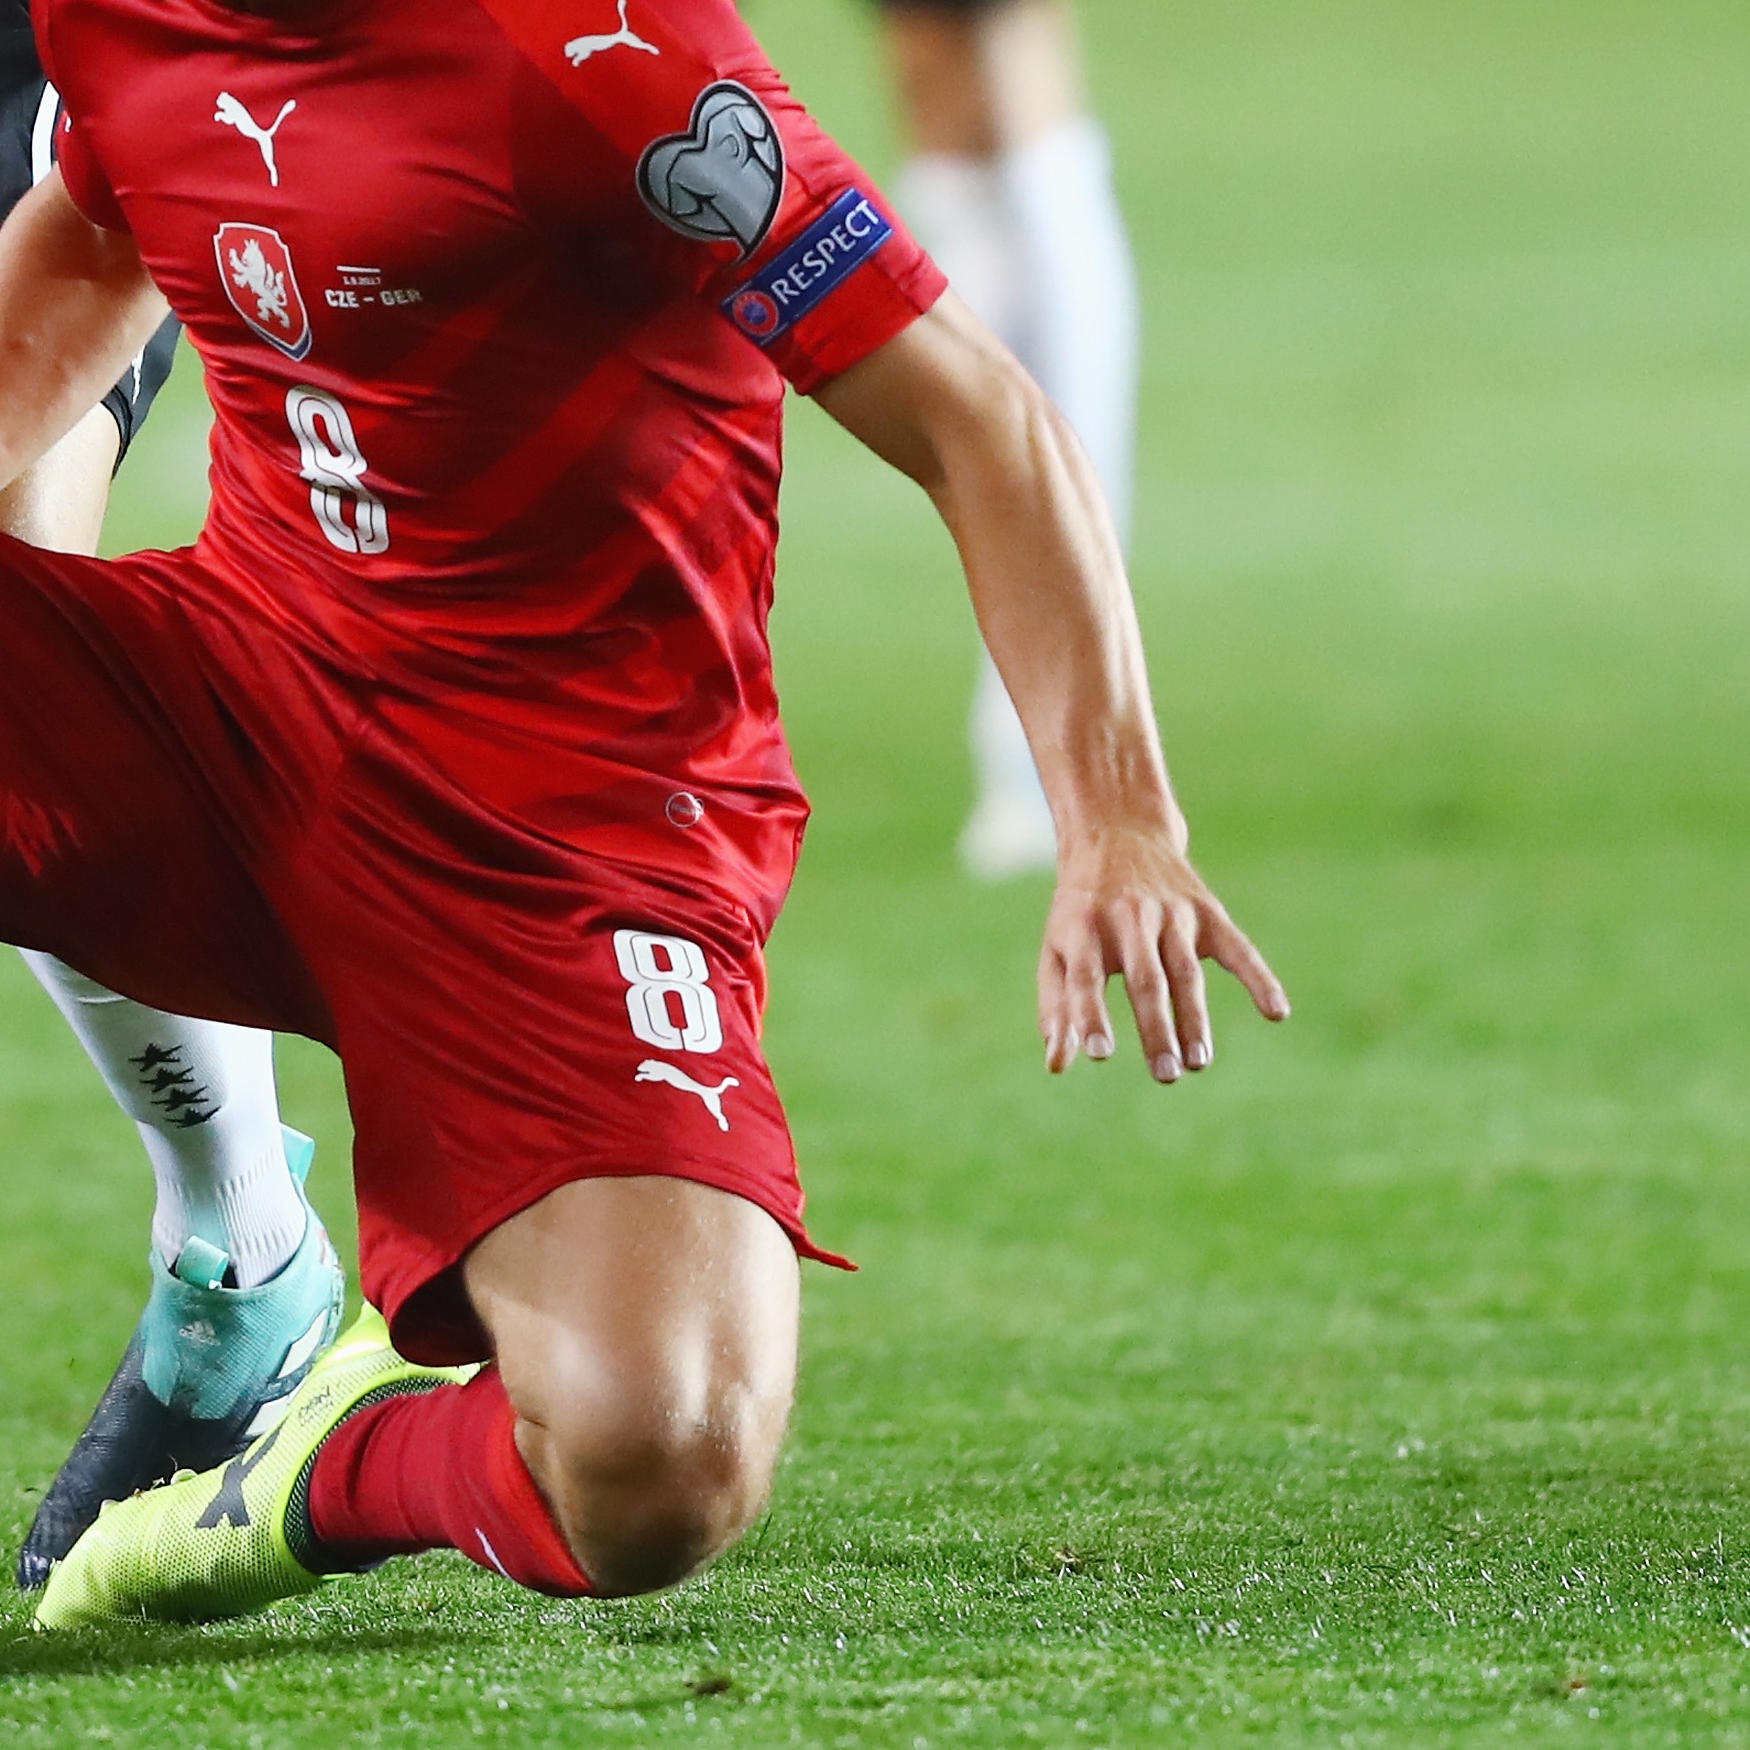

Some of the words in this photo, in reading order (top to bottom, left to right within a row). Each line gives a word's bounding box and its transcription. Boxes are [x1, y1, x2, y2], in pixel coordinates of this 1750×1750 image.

[325, 289, 360, 308] CZE
[380, 290, 423, 306] GER
[770, 200, 879, 305] RESPECT
[285, 385, 390, 554] 8
[613, 929, 723, 1054] 8
